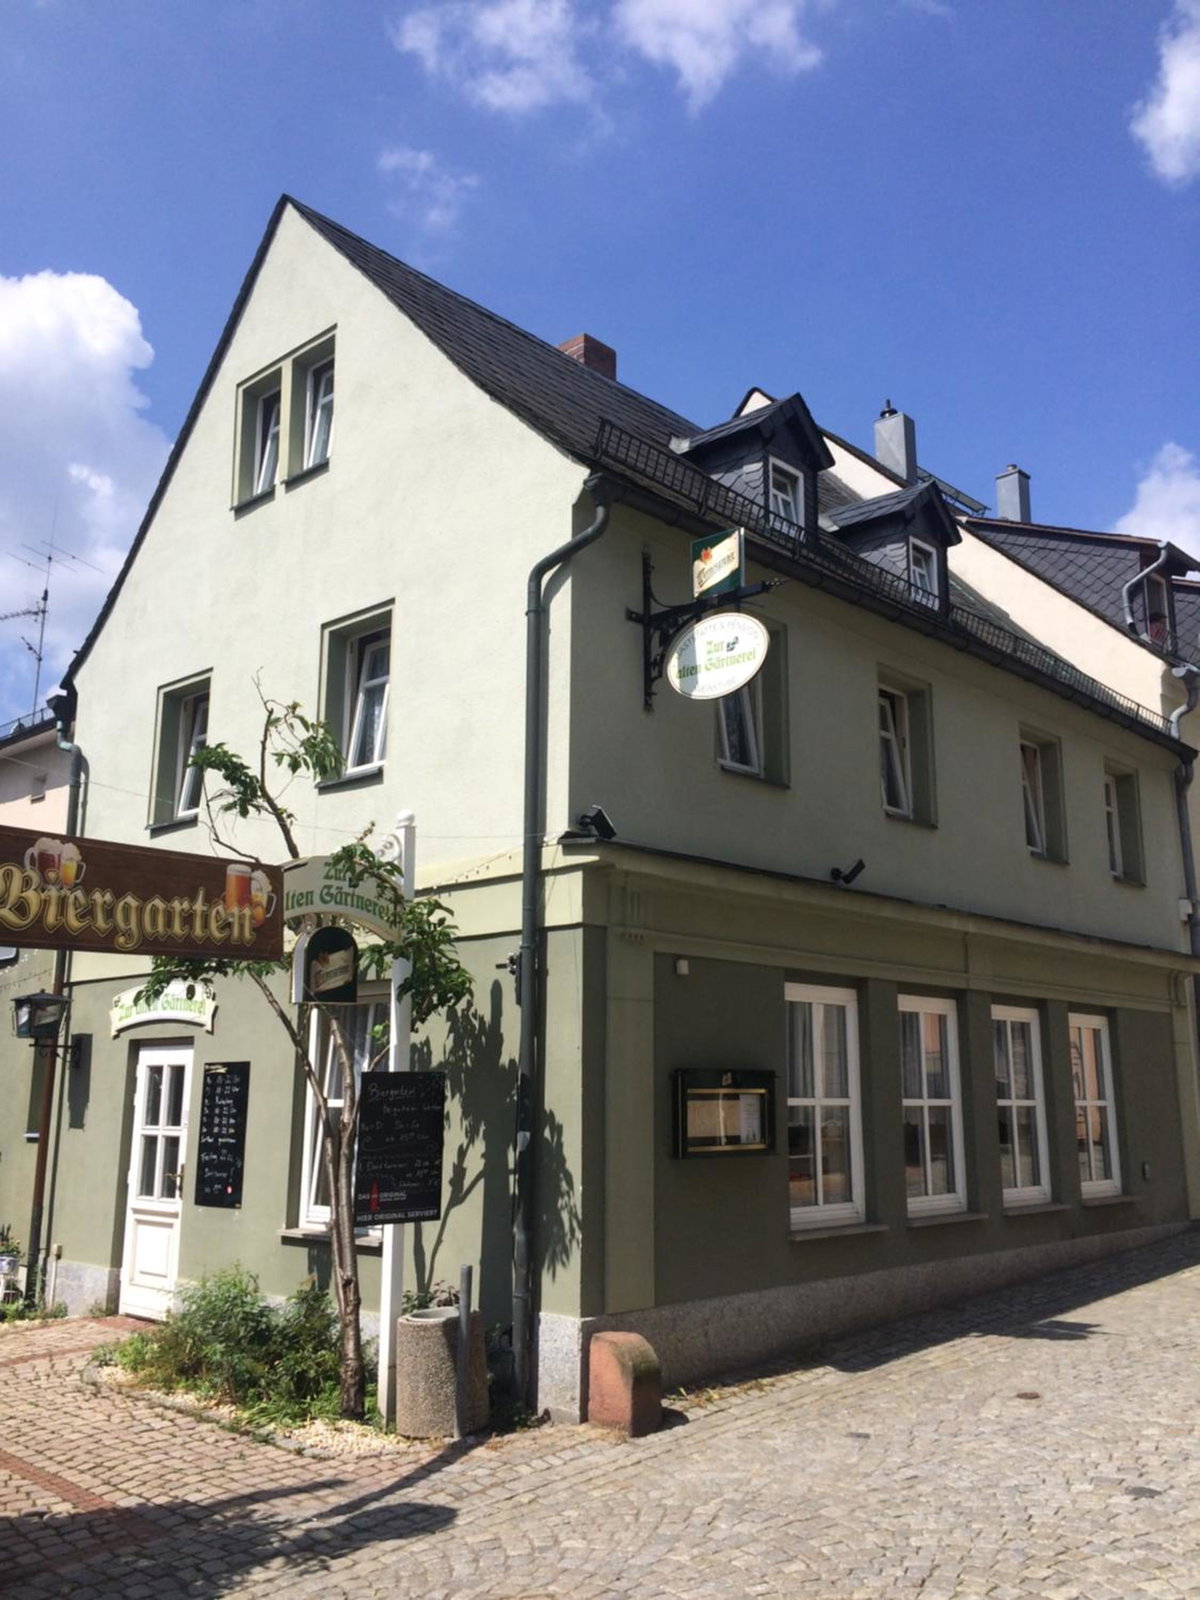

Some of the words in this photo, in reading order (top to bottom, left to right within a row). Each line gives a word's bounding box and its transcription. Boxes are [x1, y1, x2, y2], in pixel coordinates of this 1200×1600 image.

[705, 640, 725, 655] Zur
[676, 663, 702, 680] alten
[704, 648, 756, 671] Gärtnerei
[323, 862, 347, 881] Zur
[0, 862, 257, 951] Biergarten
[285, 891, 314, 911] lten
[356, 1213, 373, 1222] HIER
[374, 1211, 406, 1221] ORIGINAL
